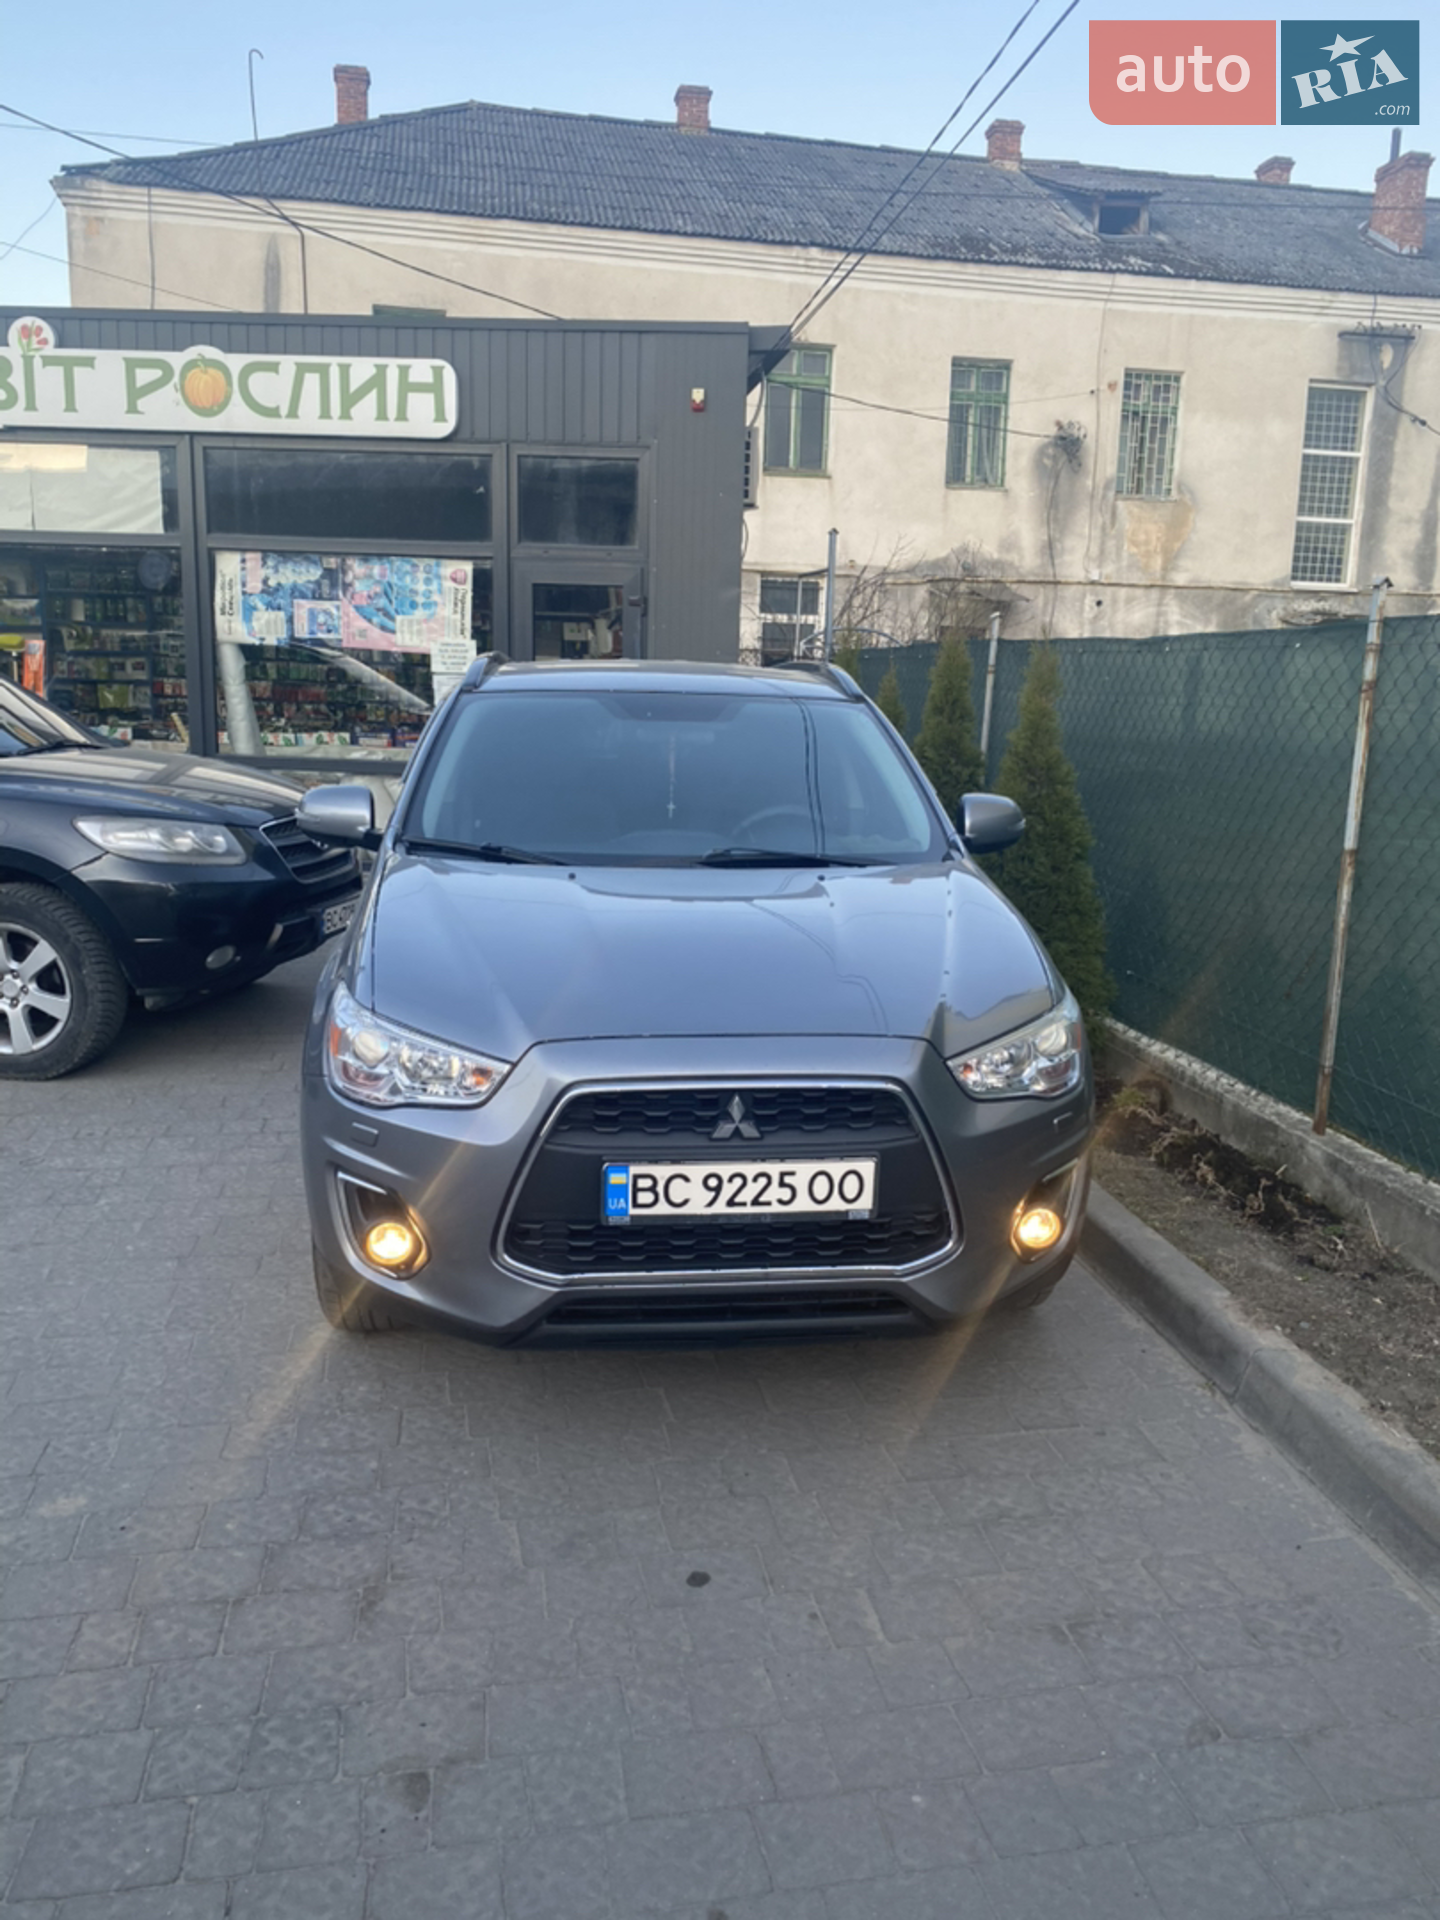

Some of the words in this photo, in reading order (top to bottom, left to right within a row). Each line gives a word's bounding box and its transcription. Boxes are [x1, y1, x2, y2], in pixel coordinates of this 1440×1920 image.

[122, 355, 447, 423] РОСЛИН
[607, 1198, 627, 1210] UA
[631, 1173, 691, 1209] BC
[702, 1171, 797, 1208] 9225
